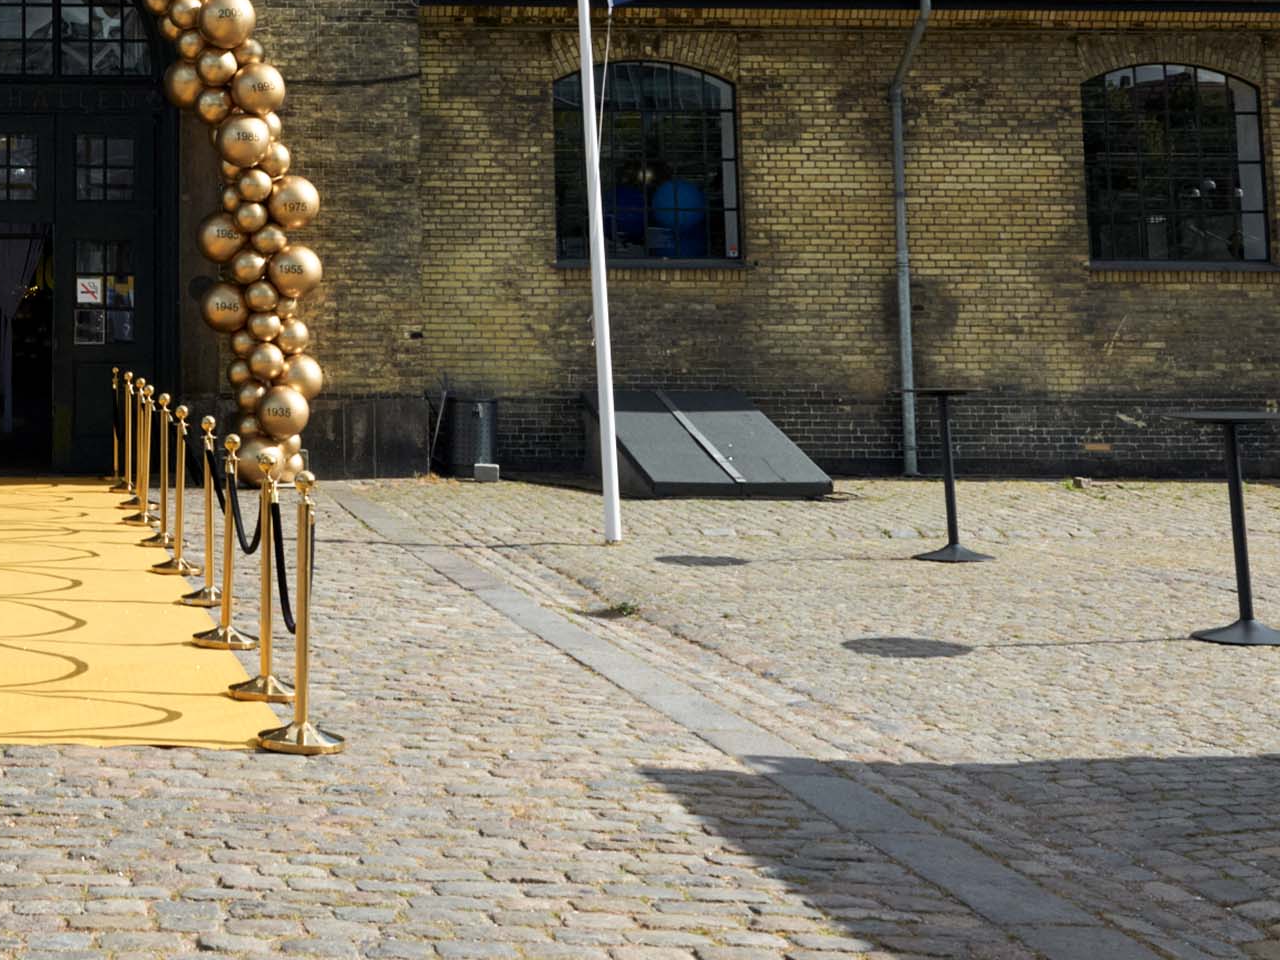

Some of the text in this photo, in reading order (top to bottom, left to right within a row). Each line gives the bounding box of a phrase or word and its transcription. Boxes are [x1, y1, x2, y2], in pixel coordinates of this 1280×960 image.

[218, 7, 244, 19] 200
[282, 201, 308, 213] 1975
[215, 301, 240, 313] 1945
[266, 407, 291, 418] 1935
